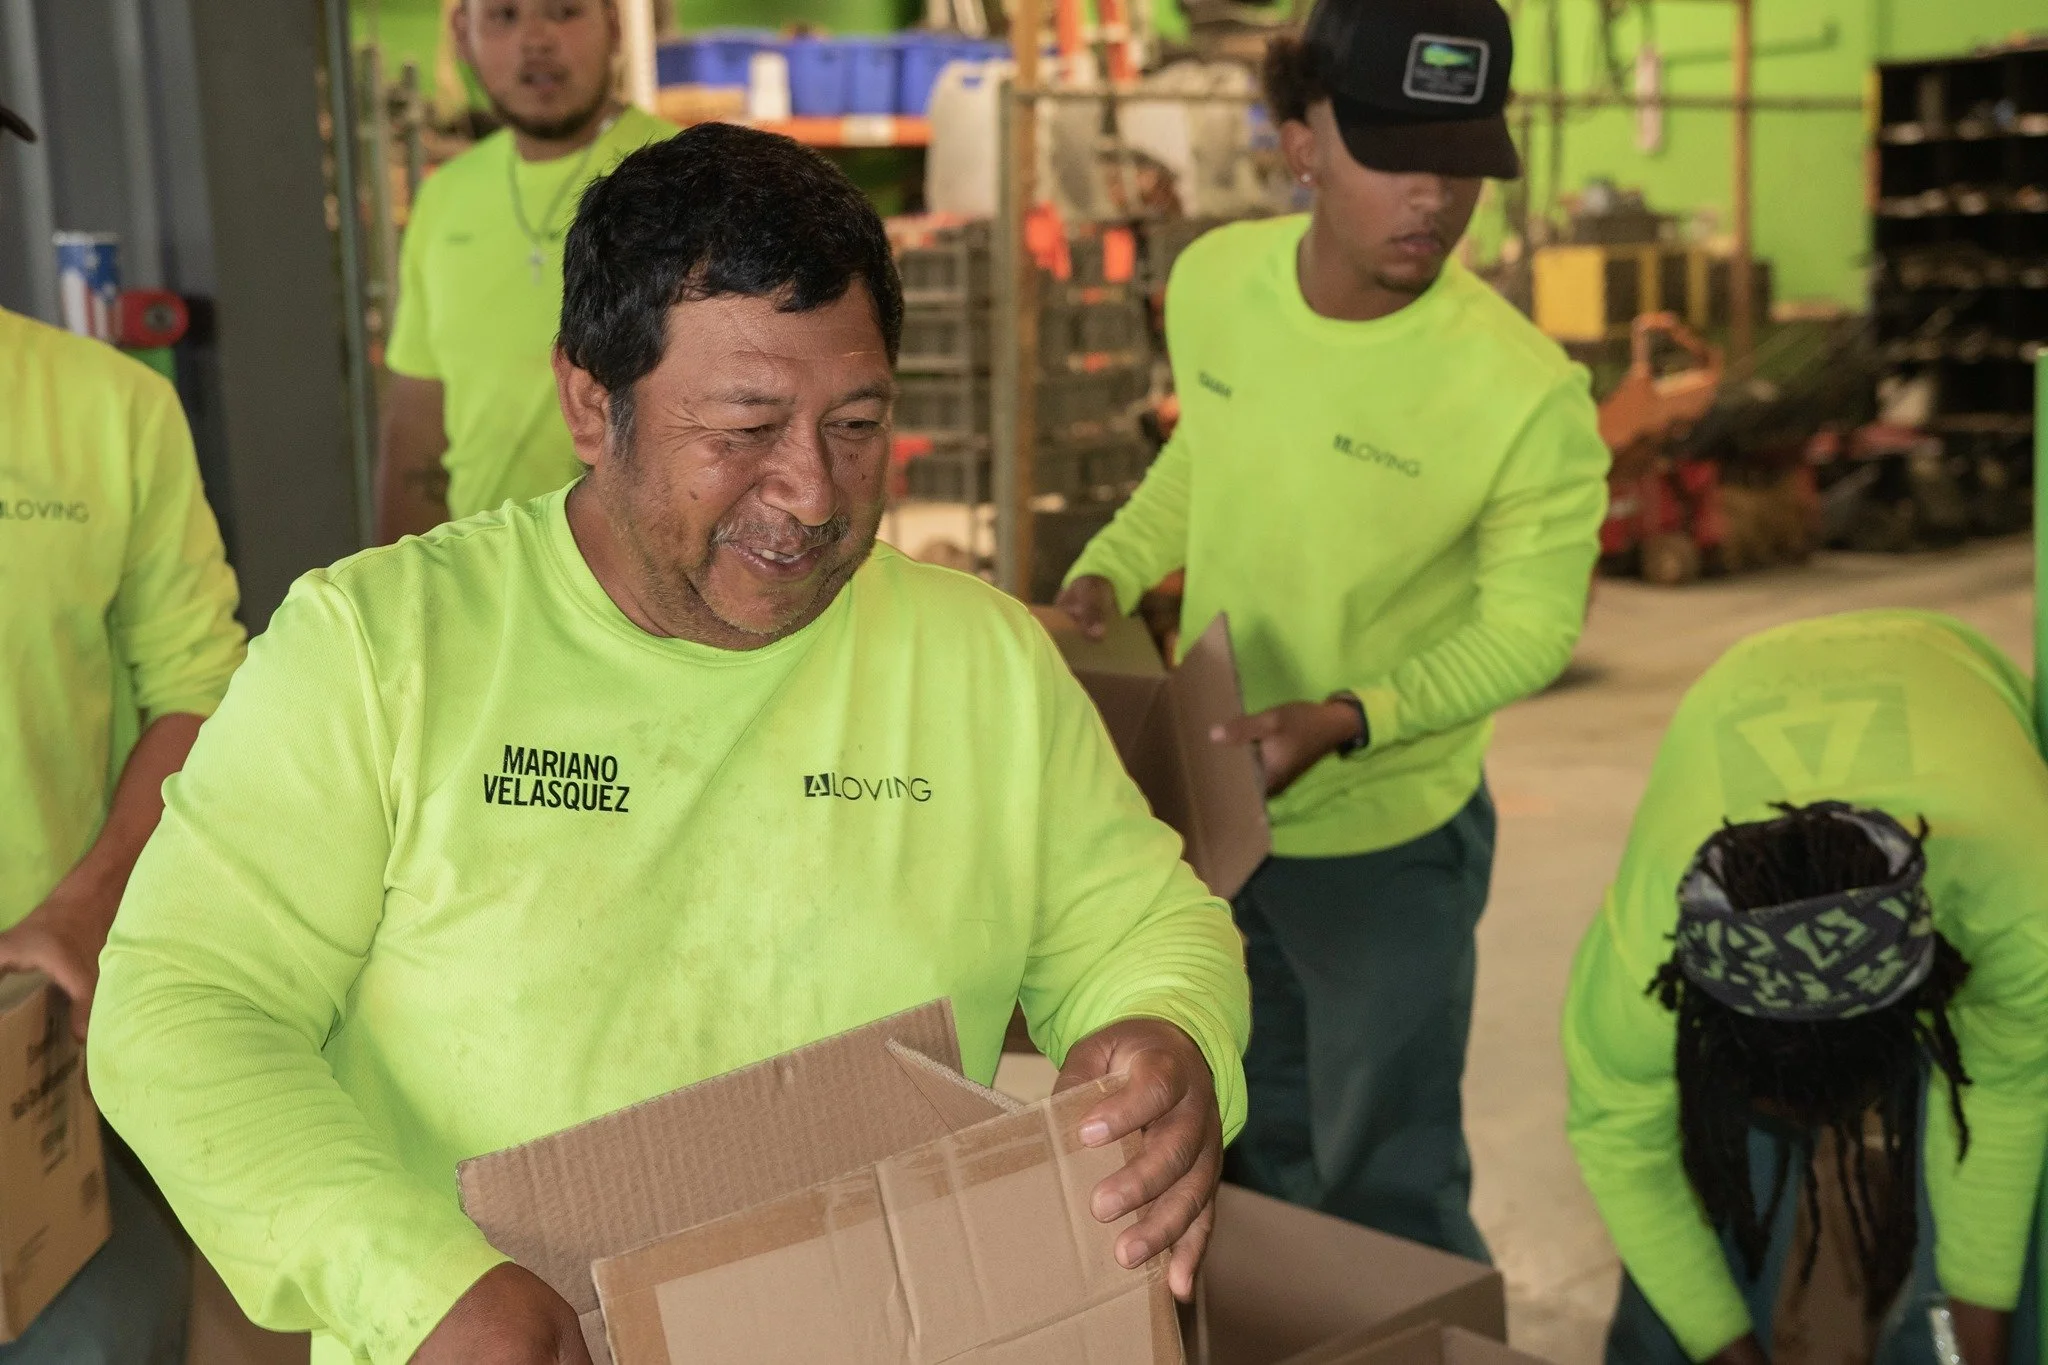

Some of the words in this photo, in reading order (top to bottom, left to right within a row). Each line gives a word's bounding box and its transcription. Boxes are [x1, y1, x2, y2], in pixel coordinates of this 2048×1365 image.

[5, 499, 90, 523] LOVING
[502, 744, 618, 783] MARIANO
[483, 773, 630, 813] VELASQUEZ
[831, 772, 932, 802] LOVING
